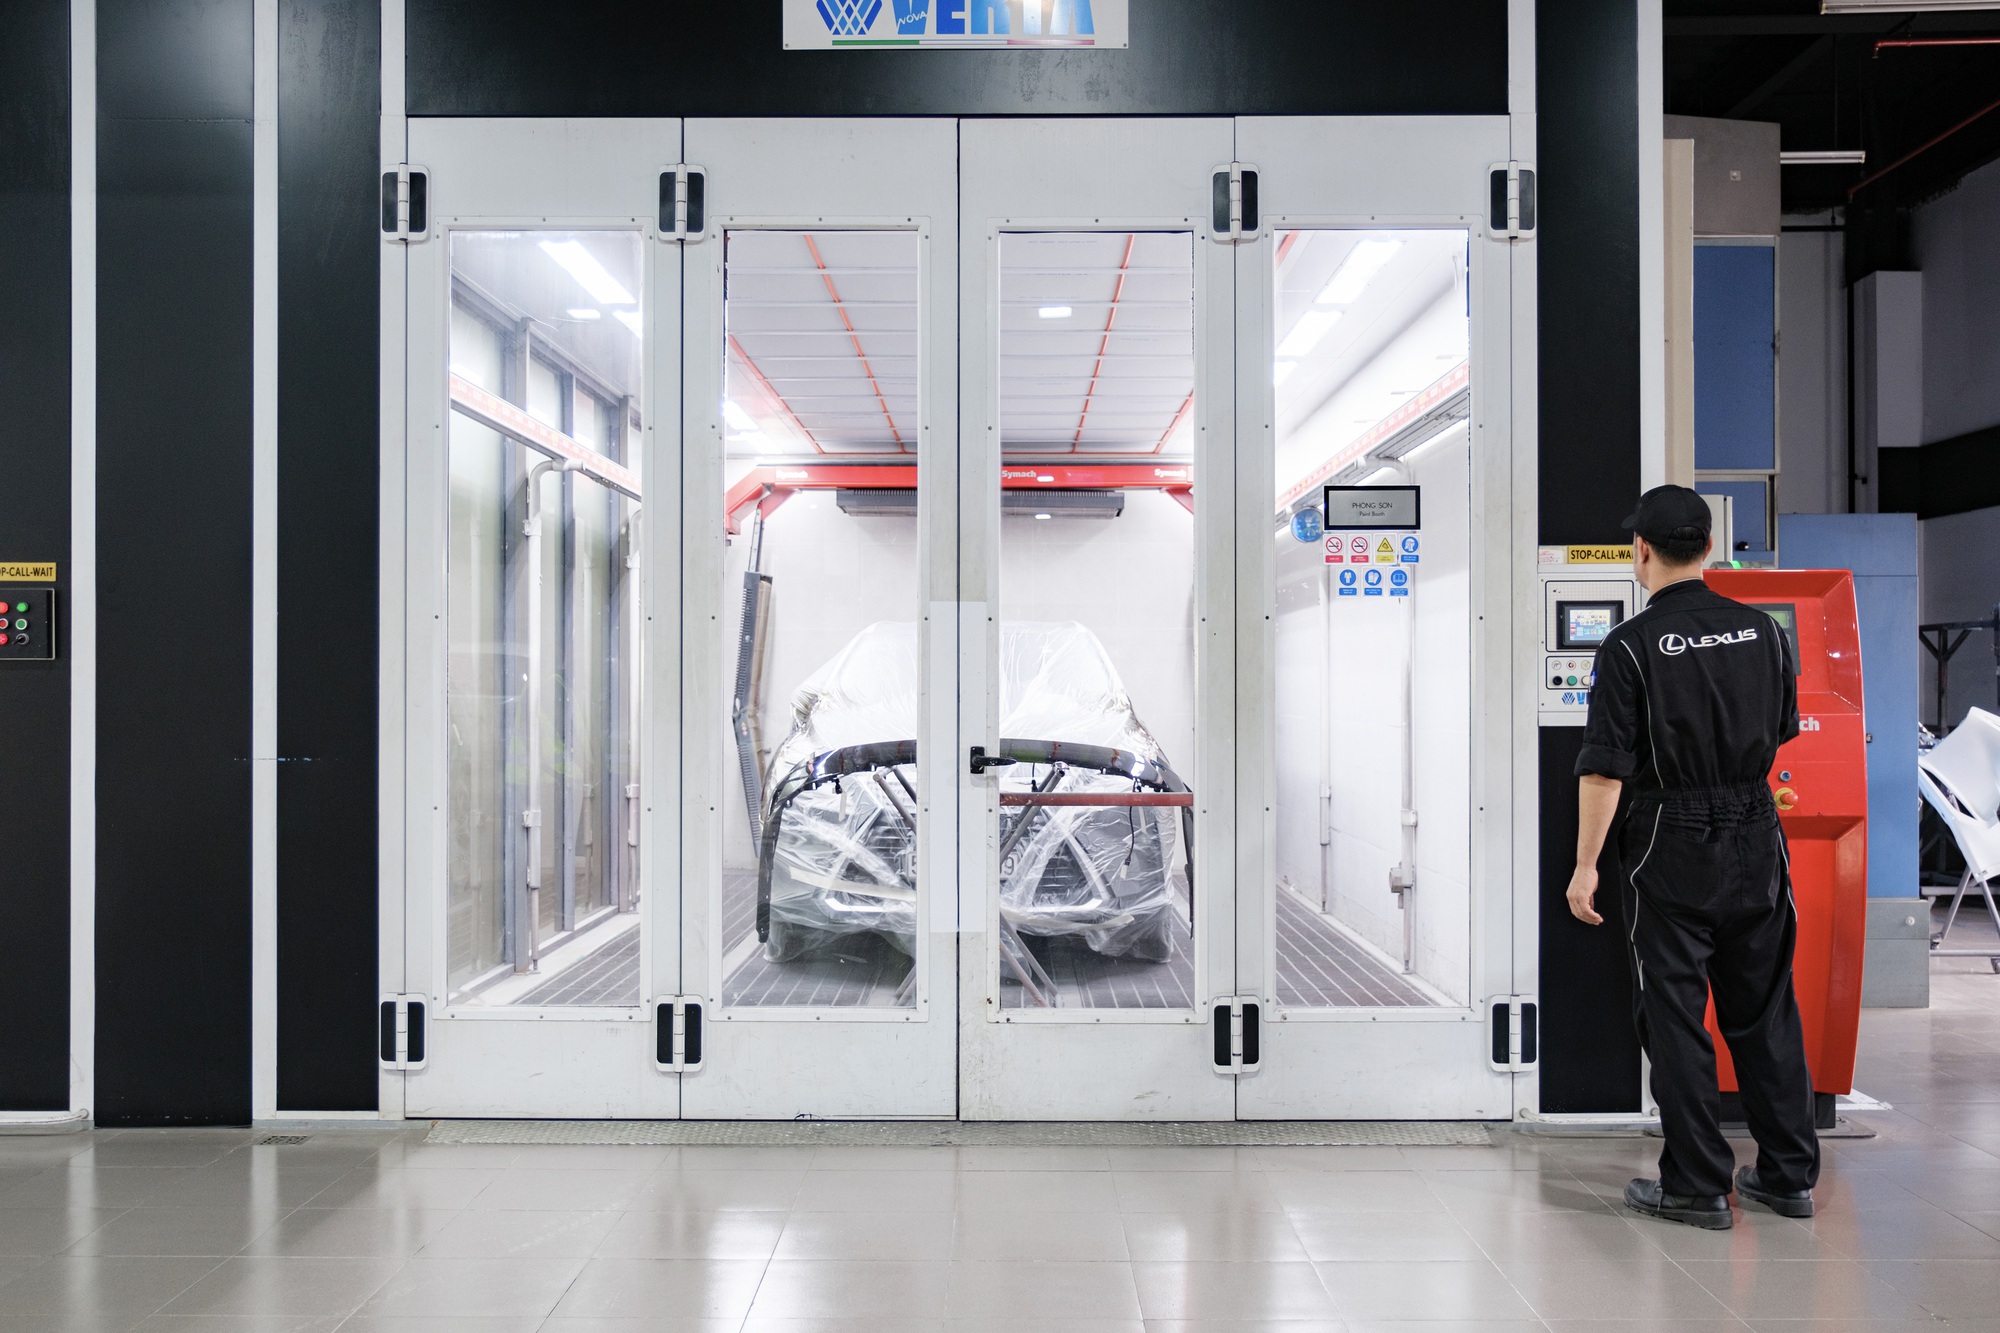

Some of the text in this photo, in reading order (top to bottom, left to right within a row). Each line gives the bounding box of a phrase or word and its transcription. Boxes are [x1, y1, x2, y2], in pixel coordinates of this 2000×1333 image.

[898, 11, 928, 26] NOVA
[1001, 470, 1037, 480] Symach
[1571, 549, 1634, 560] STOP-CALL-WA
[0, 566, 53, 577] P-CALL-WAIT
[1687, 628, 1758, 648] LEXUS
